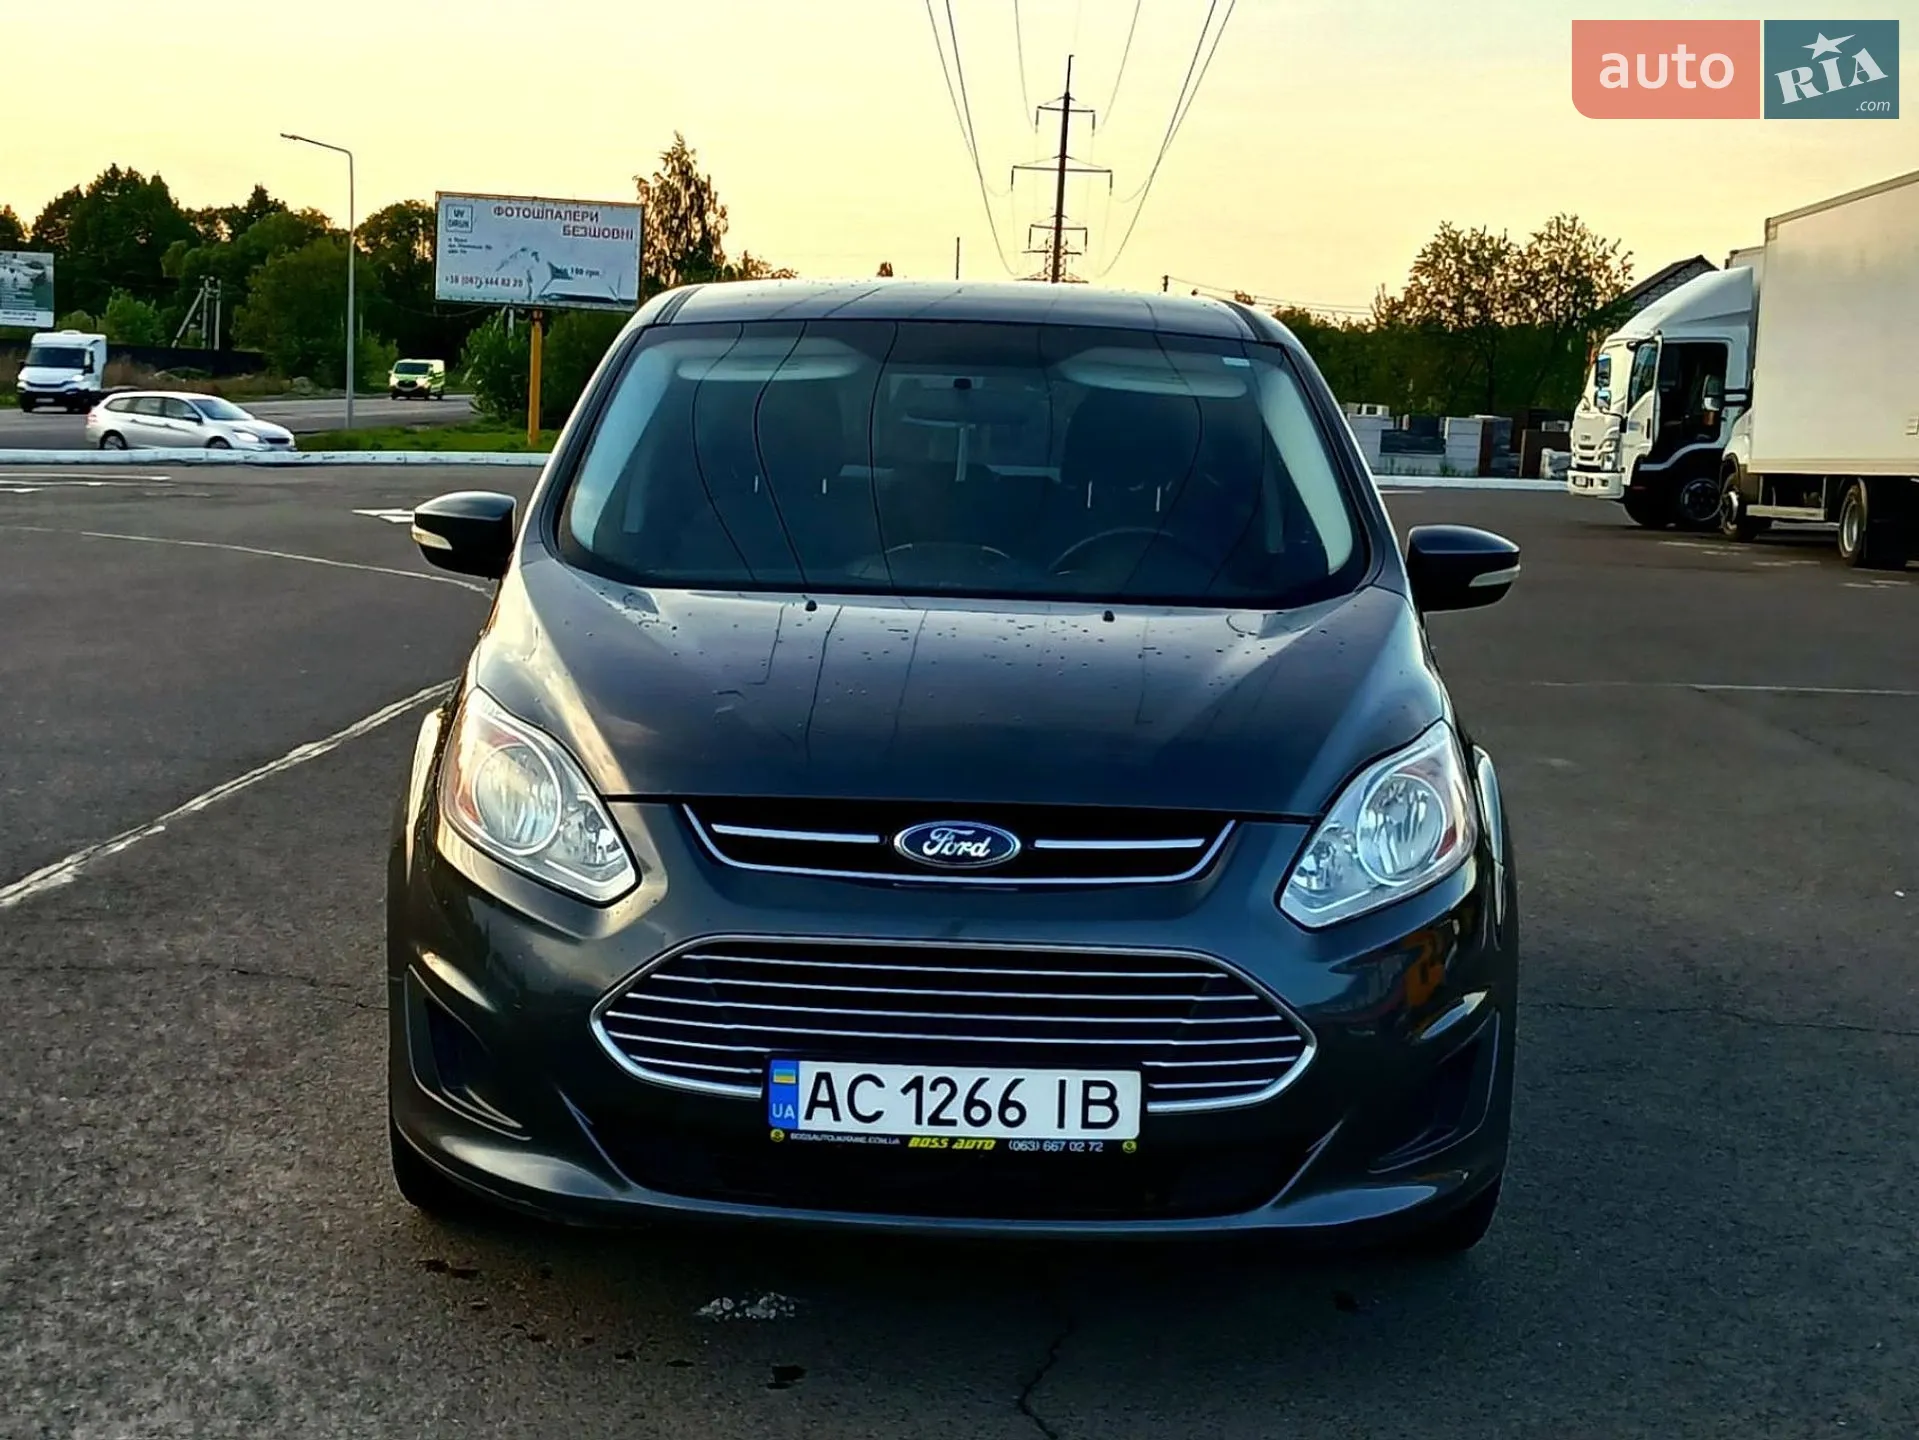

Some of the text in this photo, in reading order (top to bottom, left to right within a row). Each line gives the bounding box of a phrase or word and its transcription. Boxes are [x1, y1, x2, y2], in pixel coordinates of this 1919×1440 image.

[493, 205, 599, 223] ФОТОШПАЛЕРИ
[562, 225, 634, 241] БЕЗШОВНІ
[922, 827, 992, 857] Ford
[804, 1071, 1121, 1130] AC 1266 IB
[771, 1103, 796, 1120] UA
[908, 1136, 949, 1149] BOSS
[952, 1138, 997, 1151] AUTO
[1008, 1139, 1040, 1152] (063)
[1043, 1140, 1064, 1152] 667
[1069, 1141, 1085, 1152] 02
[1088, 1141, 1104, 1153] 72
